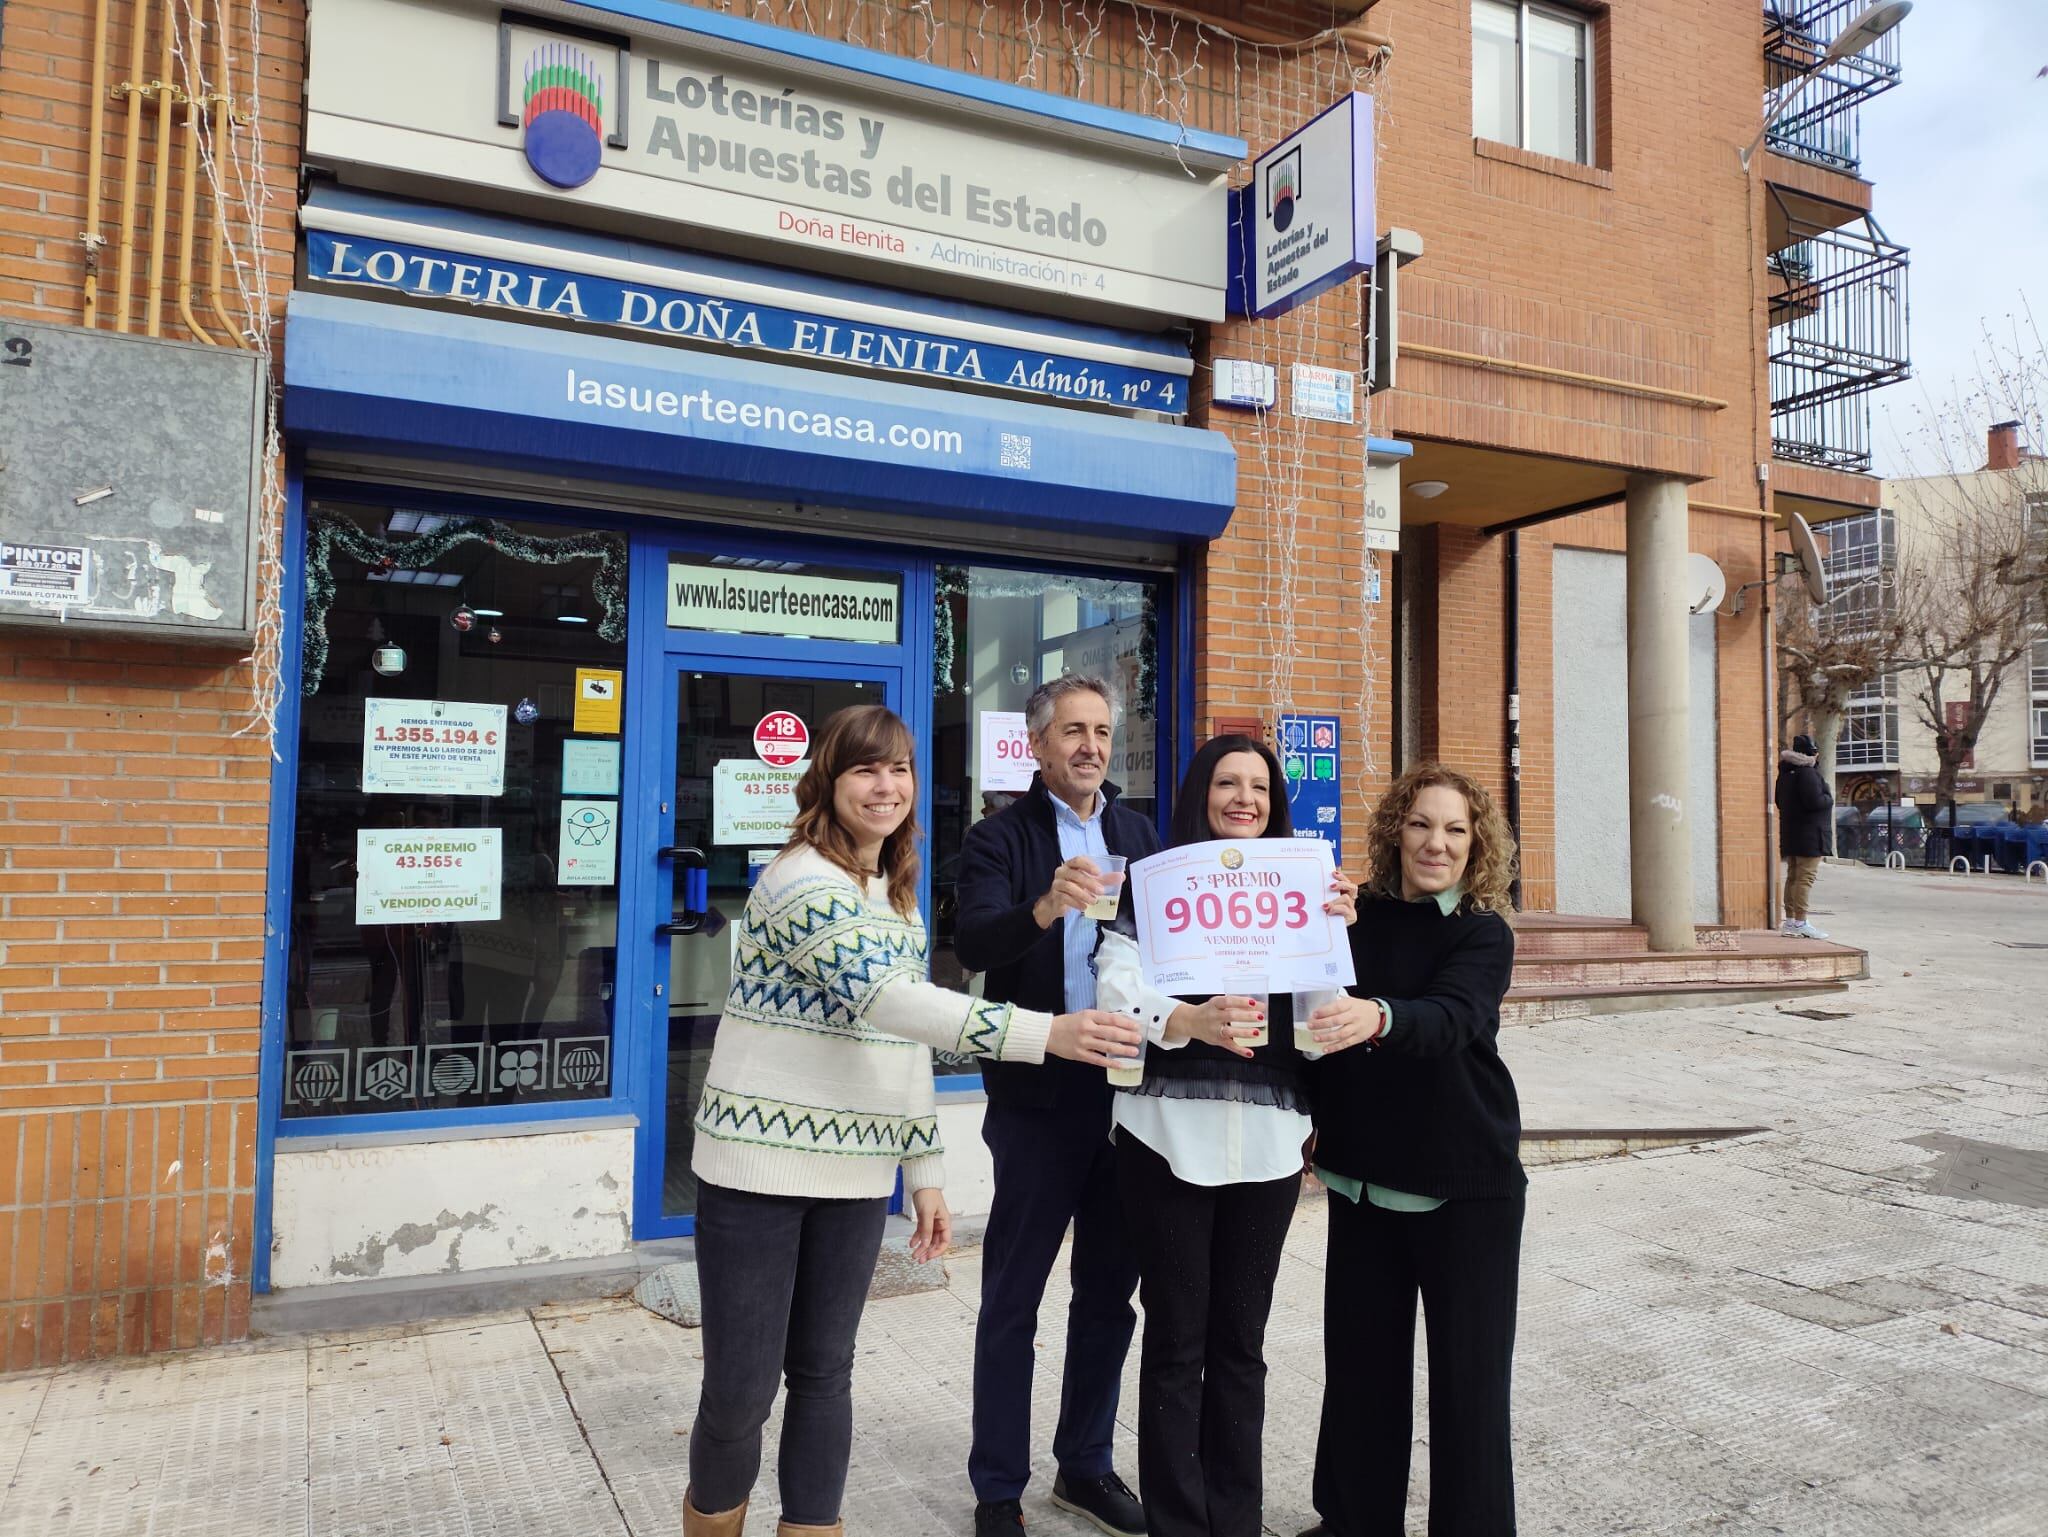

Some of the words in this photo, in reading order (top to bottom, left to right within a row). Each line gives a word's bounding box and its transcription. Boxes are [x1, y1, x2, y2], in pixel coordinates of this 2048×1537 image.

[645, 58, 845, 141] Loterías
[859, 118, 885, 160] y
[645, 115, 872, 199] Apuestas
[887, 166, 951, 217] del
[966, 184, 1108, 247] Estado
[777, 210, 834, 241] Doña
[841, 223, 905, 254] Elenita
[930, 240, 1067, 287] Administración
[1095, 274, 1106, 291] 4
[1267, 243, 1311, 276] Apuestas
[1313, 228, 1328, 249] del
[1267, 267, 1299, 294] Estado
[327, 242, 588, 317] LOTERIA
[616, 289, 766, 345] DOÑA
[788, 320, 984, 380] ELENITA
[1006, 358, 1112, 400] Admón.
[1158, 381, 1177, 405] 4
[566, 369, 963, 455] lasuerteencasa.com
[2, 546, 81, 566] PINTOR
[35, 591, 79, 600] FLOTANTE
[676, 578, 893, 622] www.lasuerteencasa.com
[430, 719, 473, 728] ENTREGADO
[766, 717, 797, 736] +18
[375, 726, 479, 745] 1.355.194
[484, 731, 498, 746] €
[386, 745, 421, 753] PREMIOS
[422, 753, 446, 761] PUNTO
[997, 739, 1035, 759] 906
[735, 772, 766, 782] GRAN
[744, 783, 790, 795] 43.565
[384, 843, 423, 854] GRAN
[426, 842, 477, 853] PREMIO
[395, 855, 453, 868] 43.565
[454, 857, 463, 868] €
[1207, 871, 1282, 889] PREMIO
[380, 897, 440, 909] VENDIDO
[443, 893, 478, 908] AQUÍ
[1164, 890, 1309, 934] 90693
[1203, 935, 1248, 946] VENDIDO
